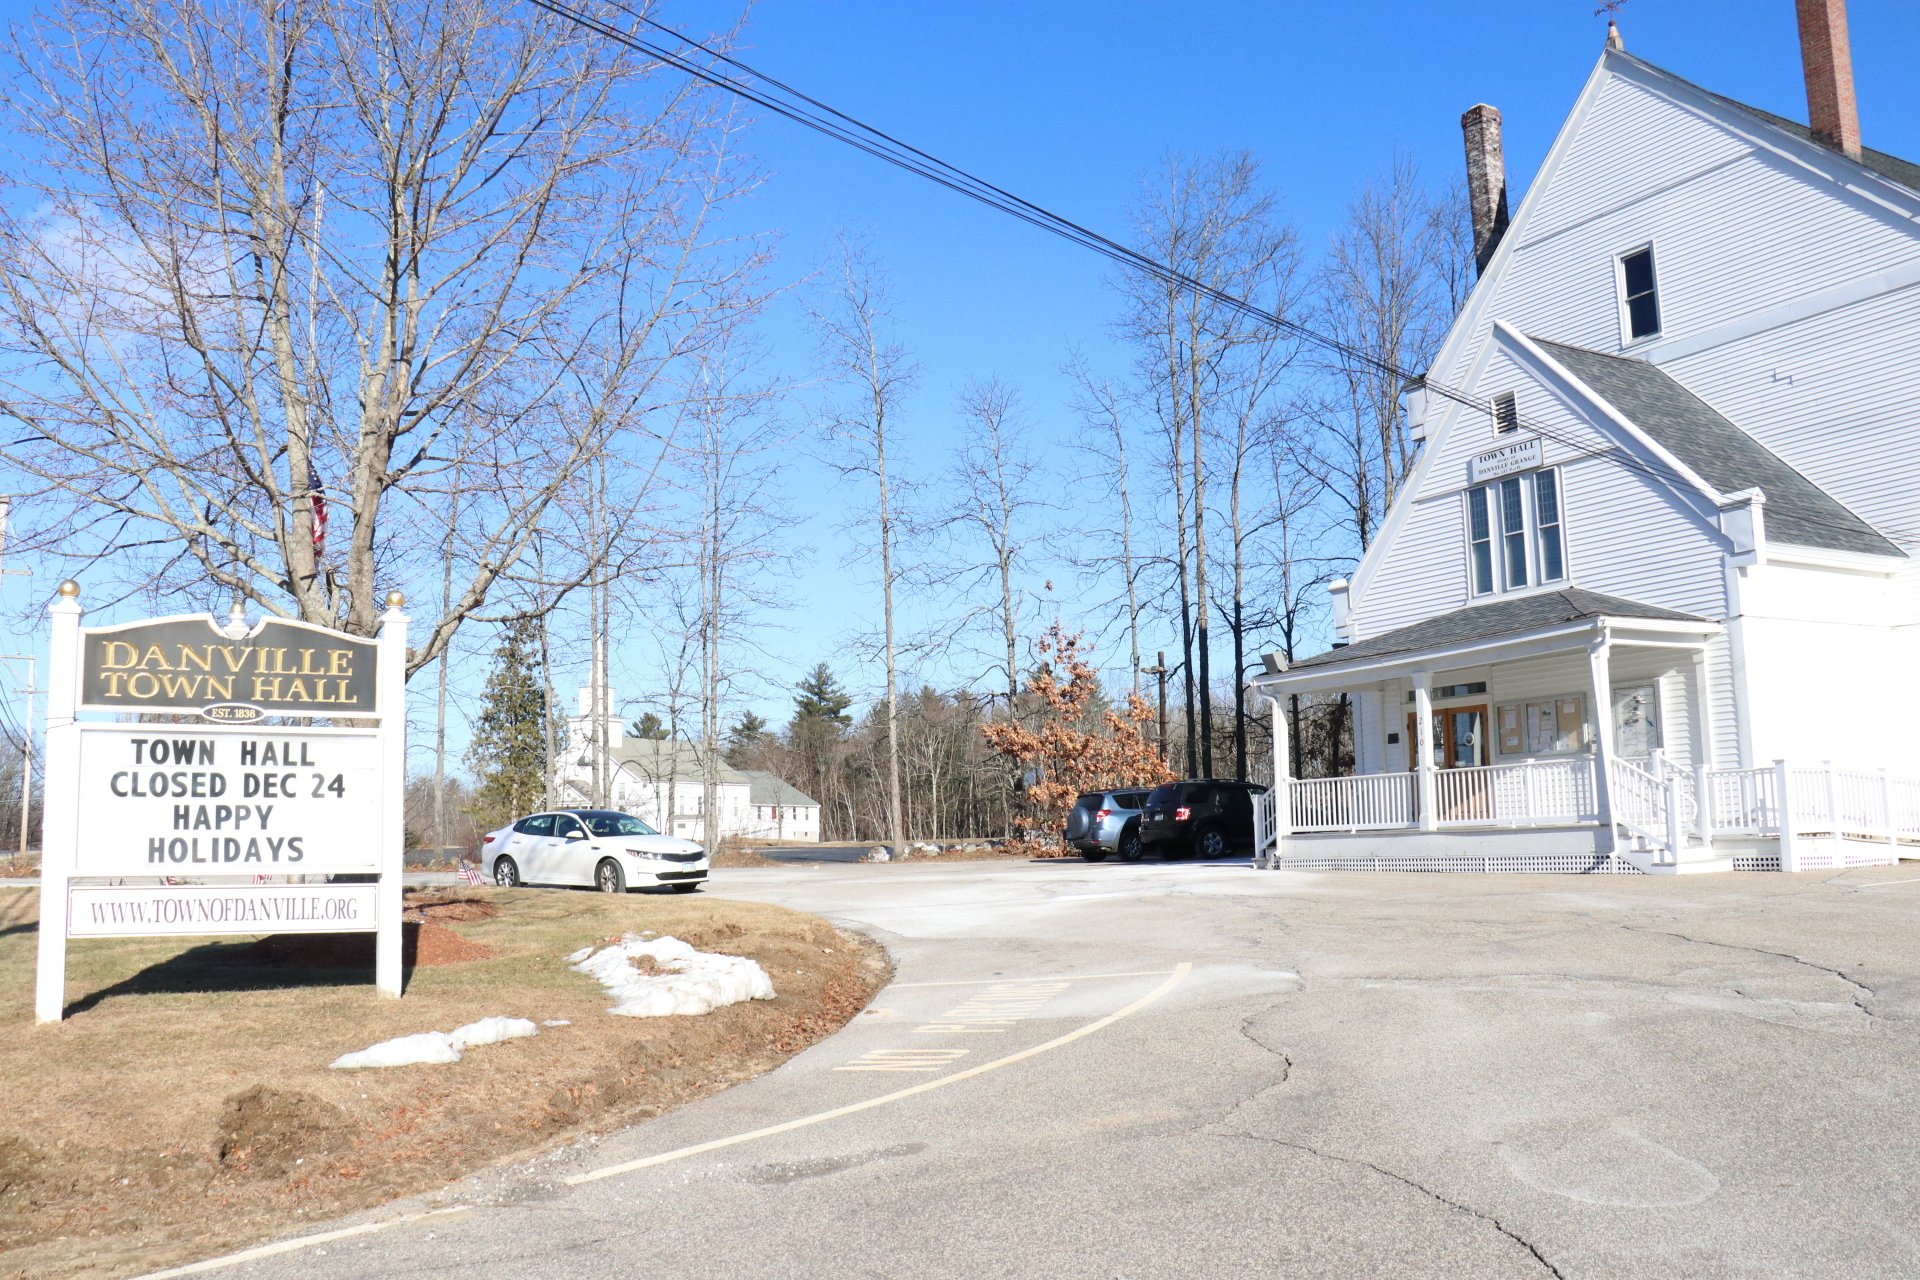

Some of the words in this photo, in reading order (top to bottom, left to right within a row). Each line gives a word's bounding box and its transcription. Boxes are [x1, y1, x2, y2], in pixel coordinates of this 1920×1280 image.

[1479, 450, 1505, 463] TOWN
[1510, 442, 1535, 454] HALL
[1479, 463, 1508, 475] DANVILLE
[1510, 455, 1536, 466] GRANGE
[101, 641, 353, 676] DANVILLE
[100, 672, 236, 700] TOWN
[251, 676, 358, 704] HALL
[211, 708, 233, 718] EST.
[131, 738, 216, 766] TOWN
[240, 740, 315, 767] HALL
[110, 771, 227, 798] CLOSED
[243, 773, 297, 798] DEC
[311, 773, 346, 799] 24
[173, 804, 274, 831] HAPPY
[148, 836, 305, 863] HOLIDAYS
[91, 897, 358, 924] WWW.TOWNOFDANVILLE.ORG
[832, 1049, 970, 1071] NO
[911, 982, 1071, 1033] PARKING
